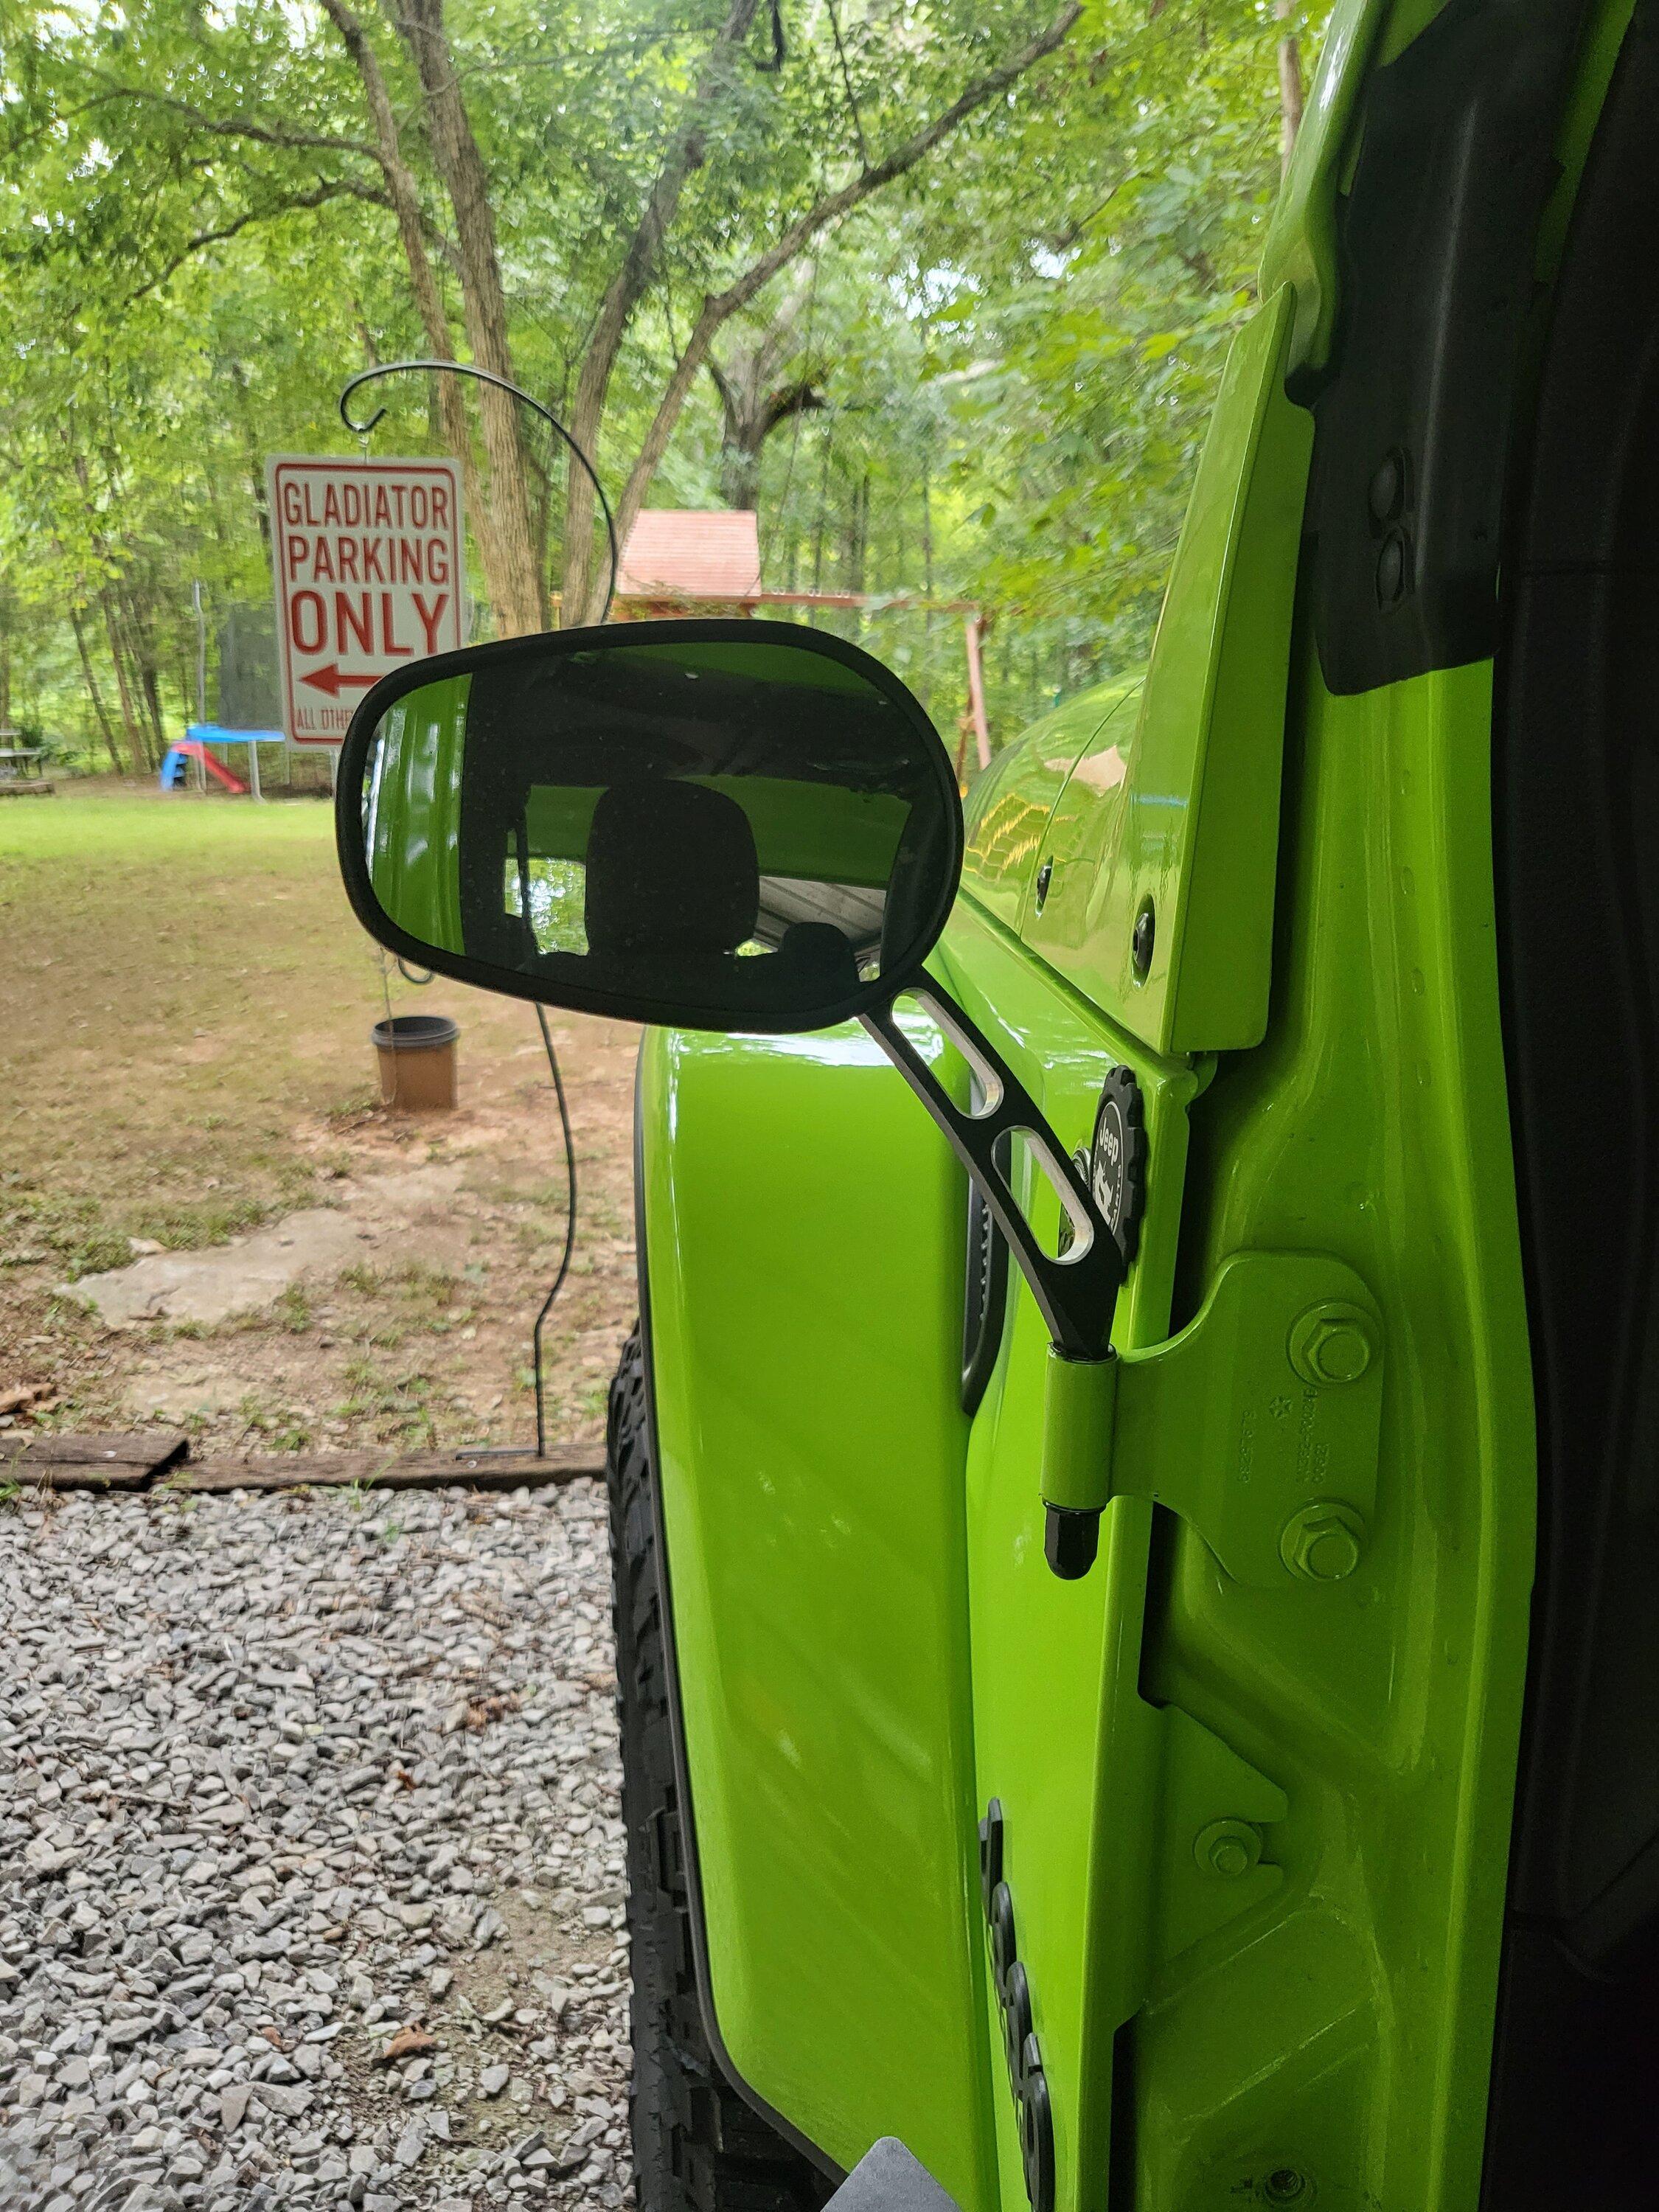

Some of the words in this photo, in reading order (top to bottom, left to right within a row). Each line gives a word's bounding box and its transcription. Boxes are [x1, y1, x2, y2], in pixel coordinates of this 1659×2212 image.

[284, 482, 449, 530] GLADIATOR
[288, 535, 449, 585] PARKING
[291, 590, 449, 655] ONLY
[297, 707, 316, 730] ALL
[1099, 1117, 1119, 1166] Jeep
